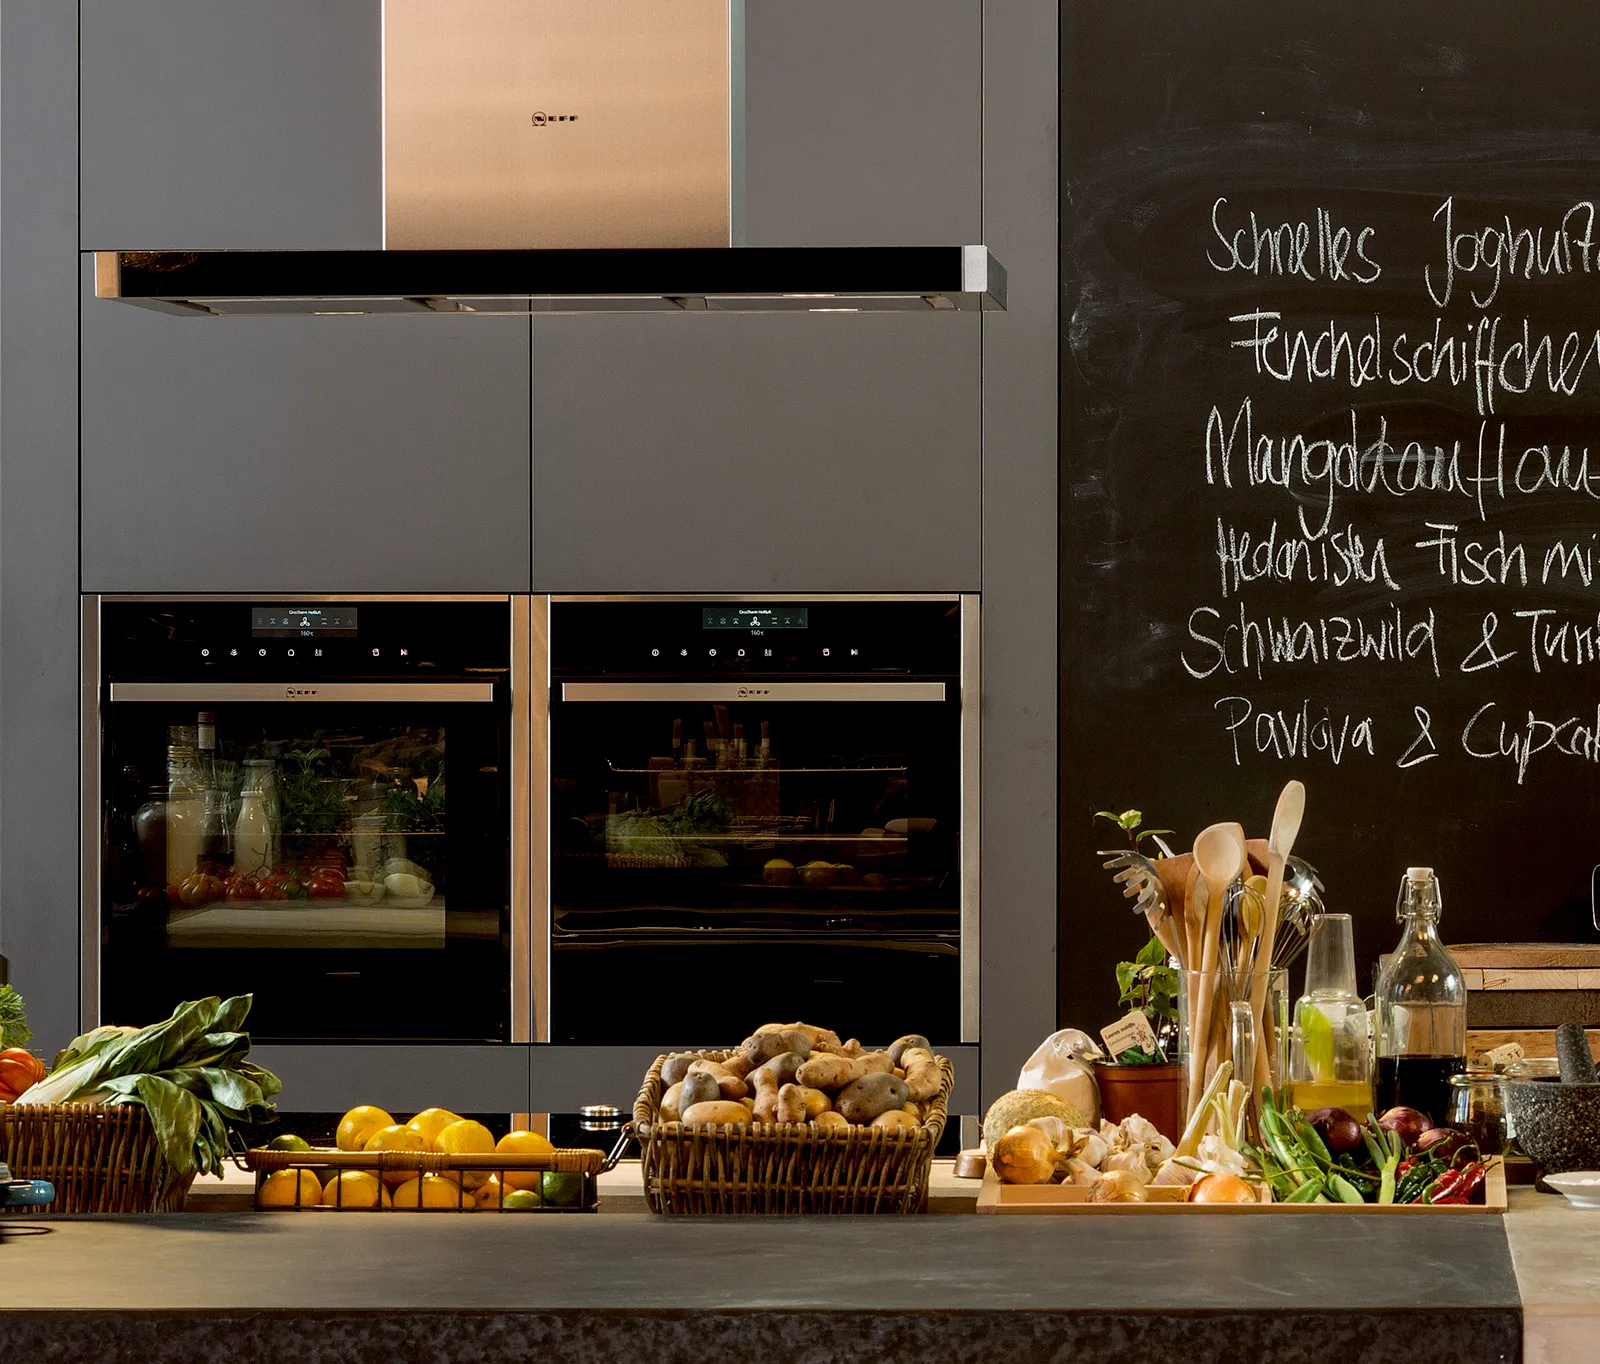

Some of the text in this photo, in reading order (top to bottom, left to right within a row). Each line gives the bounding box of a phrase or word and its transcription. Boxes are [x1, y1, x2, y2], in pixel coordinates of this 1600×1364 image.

[1207, 197, 1382, 283] Schnelles
[1415, 520, 1528, 586] Fisch
[1181, 602, 1441, 680] Schwarzwild
[1460, 611, 1518, 672] &
[1214, 696, 1374, 765] Pavlova
[1397, 706, 1440, 767] &
